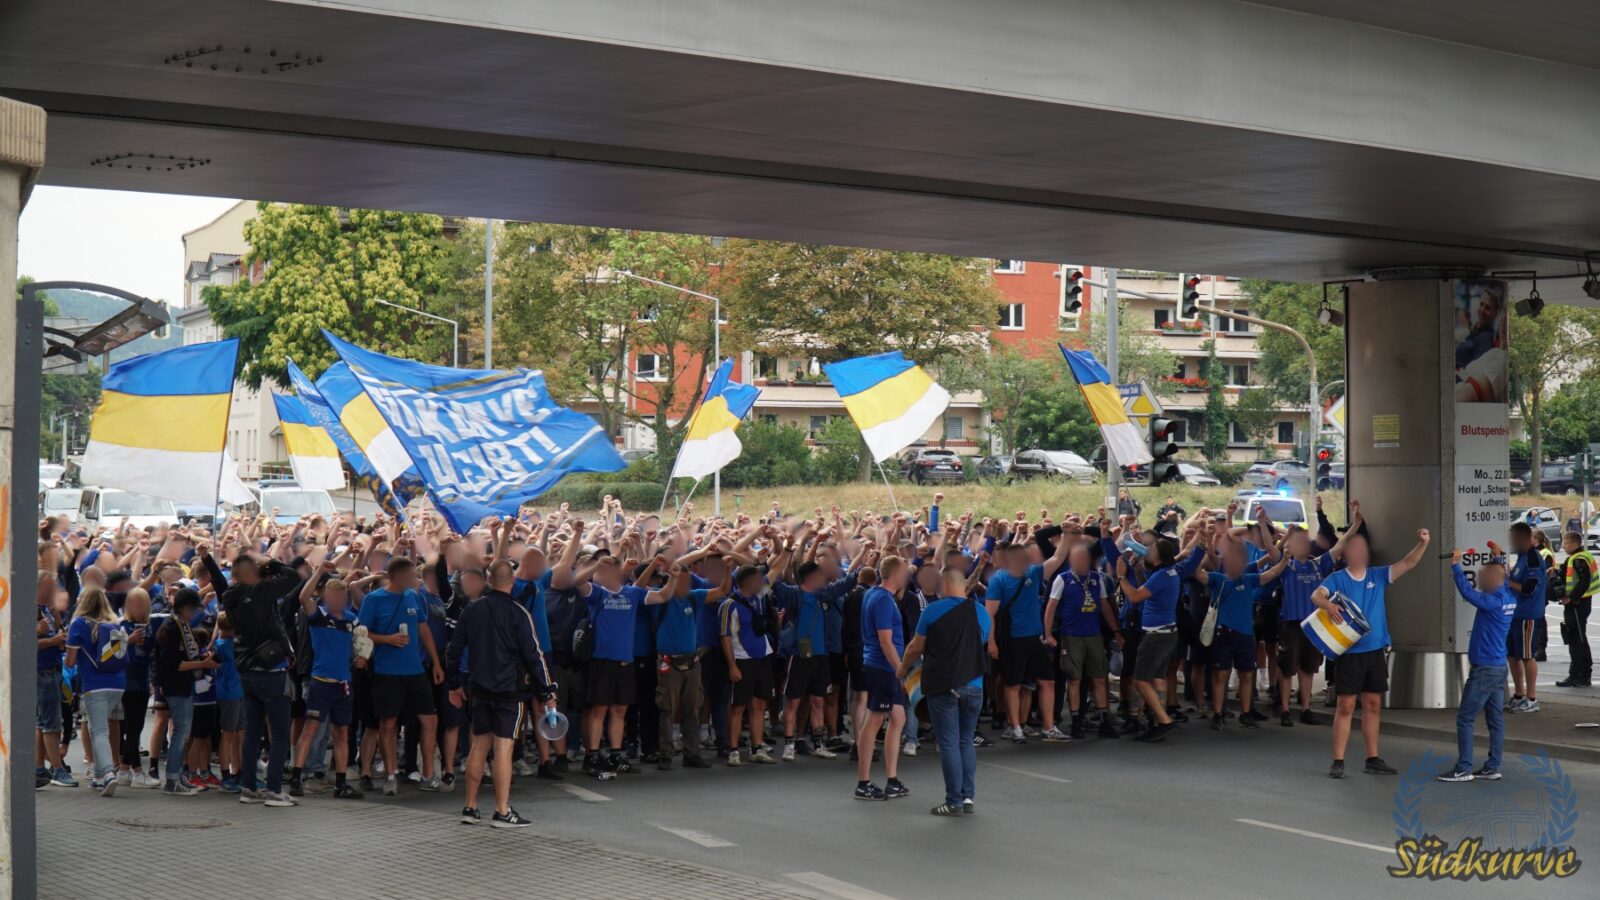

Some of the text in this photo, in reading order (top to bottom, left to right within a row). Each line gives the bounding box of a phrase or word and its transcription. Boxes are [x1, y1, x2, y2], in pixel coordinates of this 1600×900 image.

[1458, 485, 1481, 494] Hotel
[1466, 511, 1491, 522] 15:00
[1462, 552, 1507, 567] SPENE
